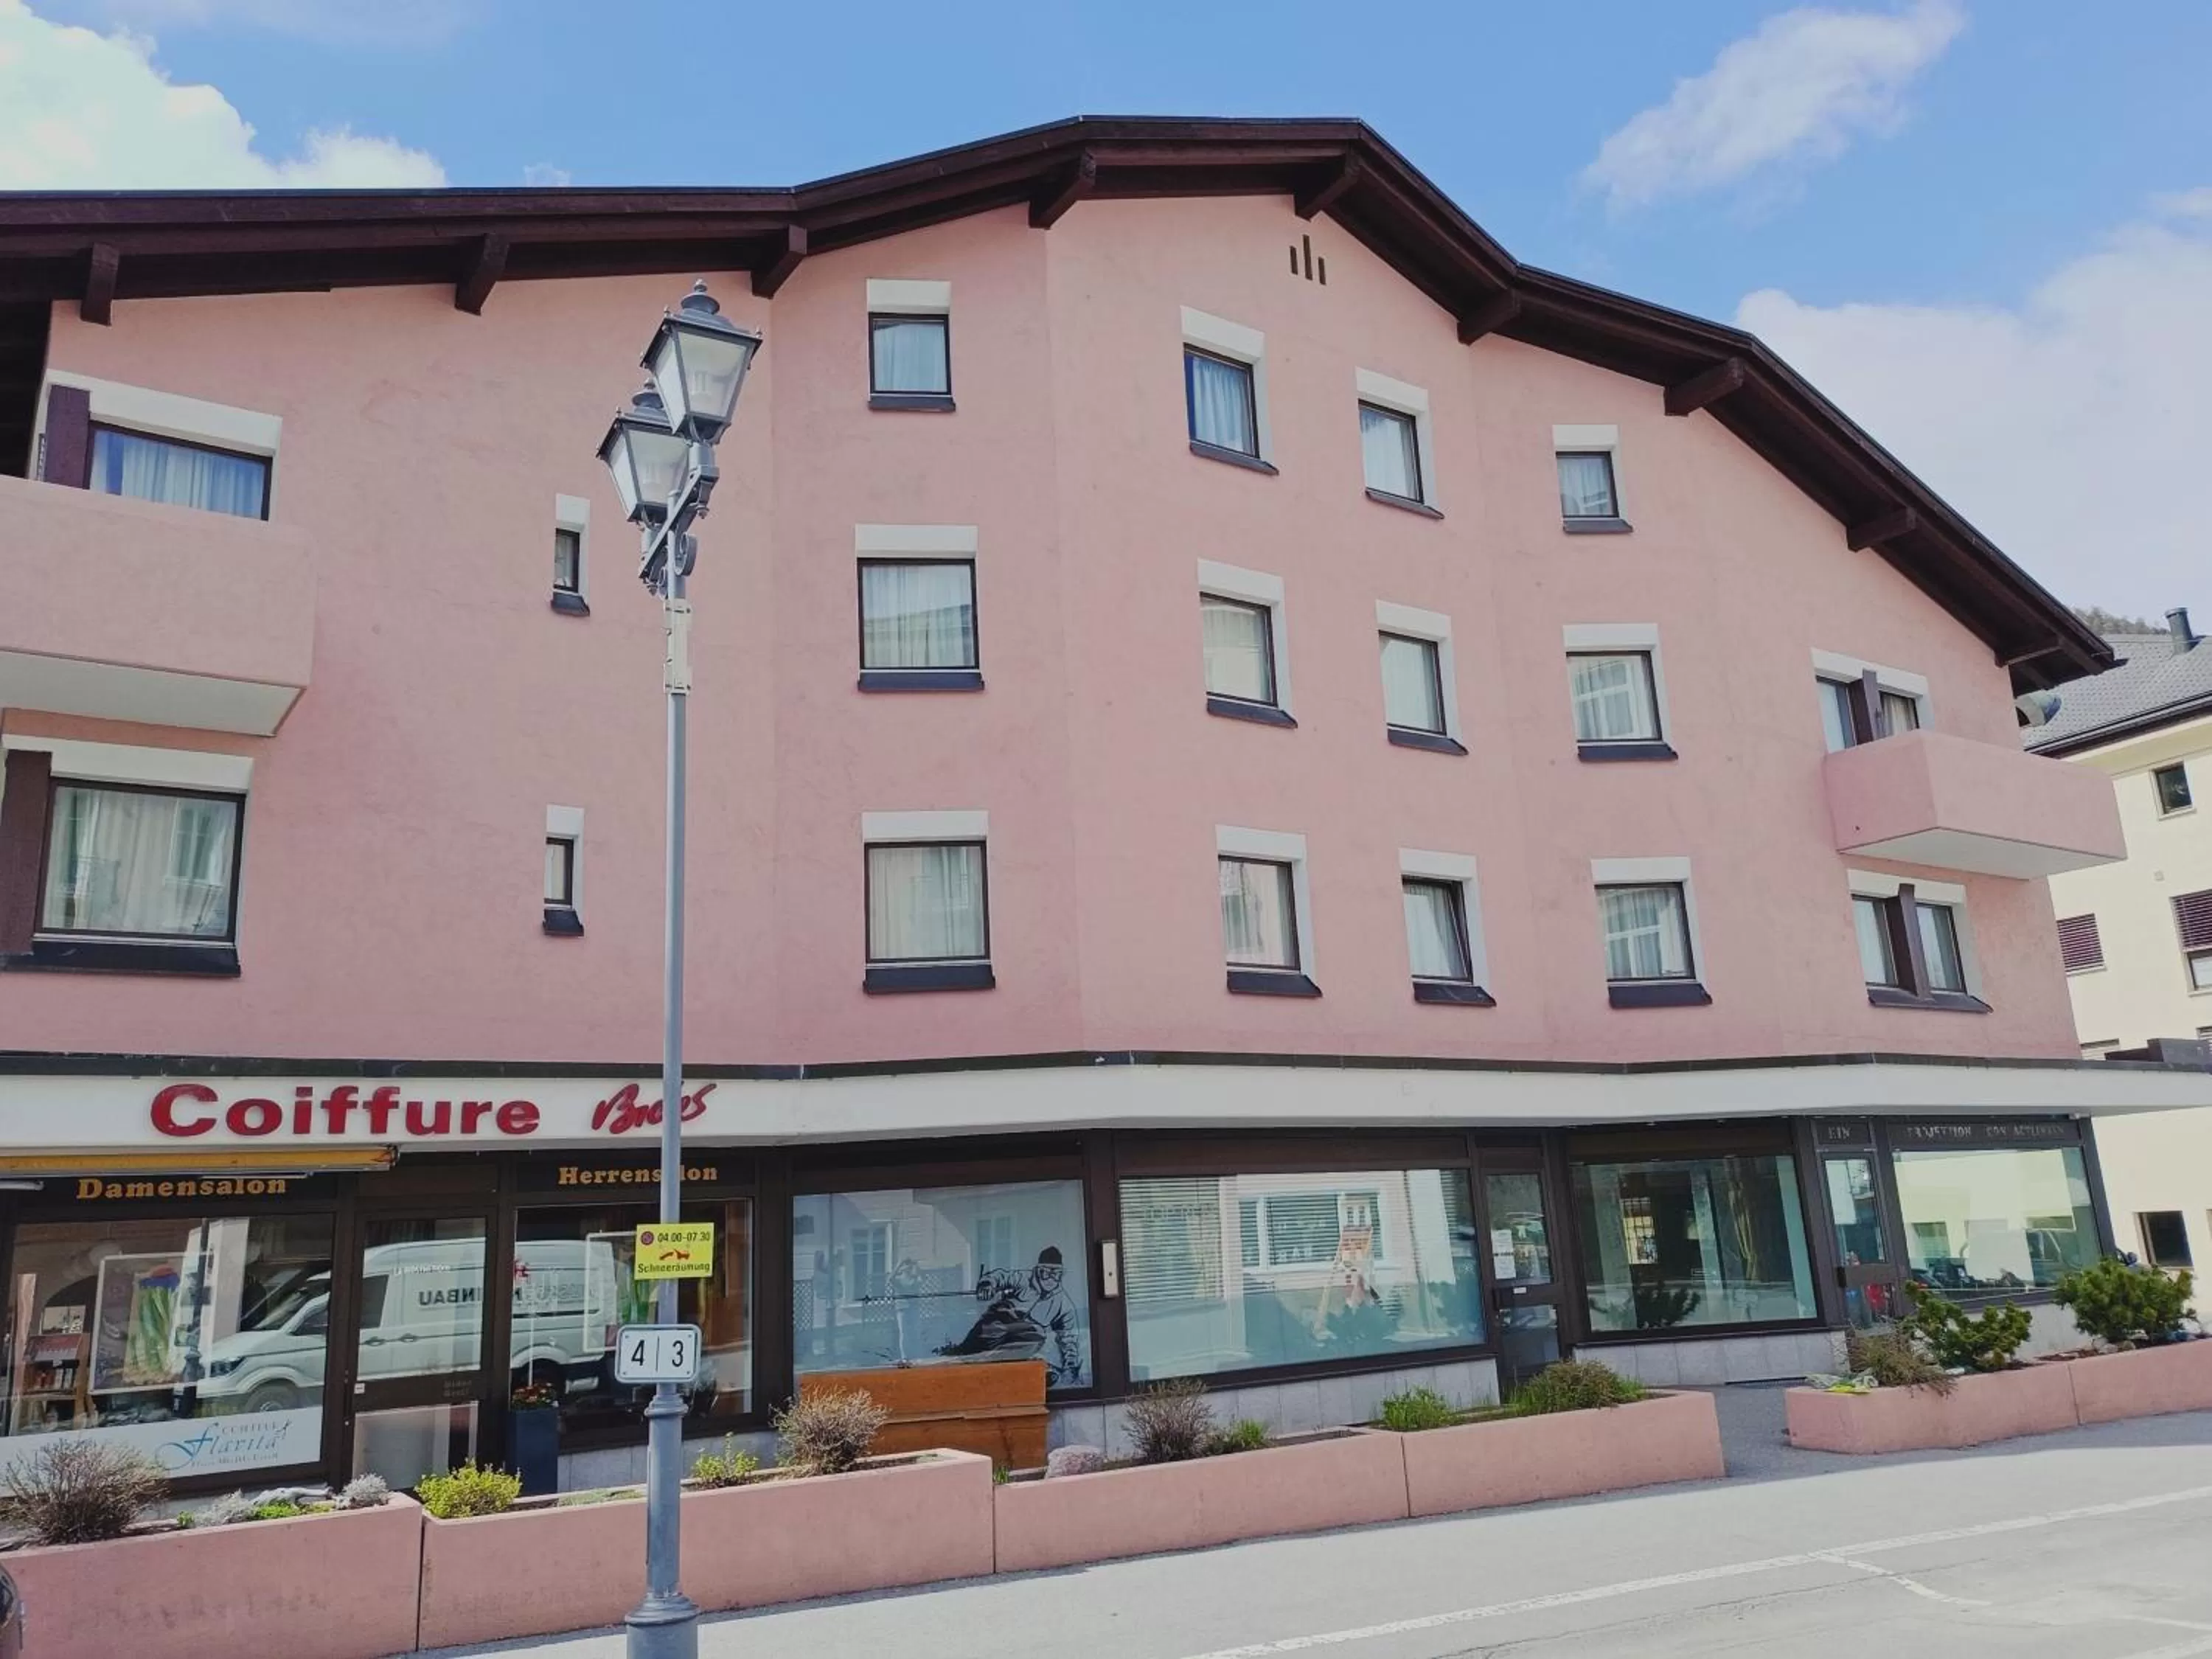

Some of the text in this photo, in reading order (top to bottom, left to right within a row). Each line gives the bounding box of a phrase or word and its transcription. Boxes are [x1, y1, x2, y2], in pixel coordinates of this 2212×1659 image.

[150, 1083, 540, 1136] Coiffure
[558, 1165, 718, 1185] Herrenslon
[77, 1178, 286, 1199] Damensalon
[637, 1262, 711, 1273] Schneeräumung
[631, 1339, 684, 1368] 4 3
